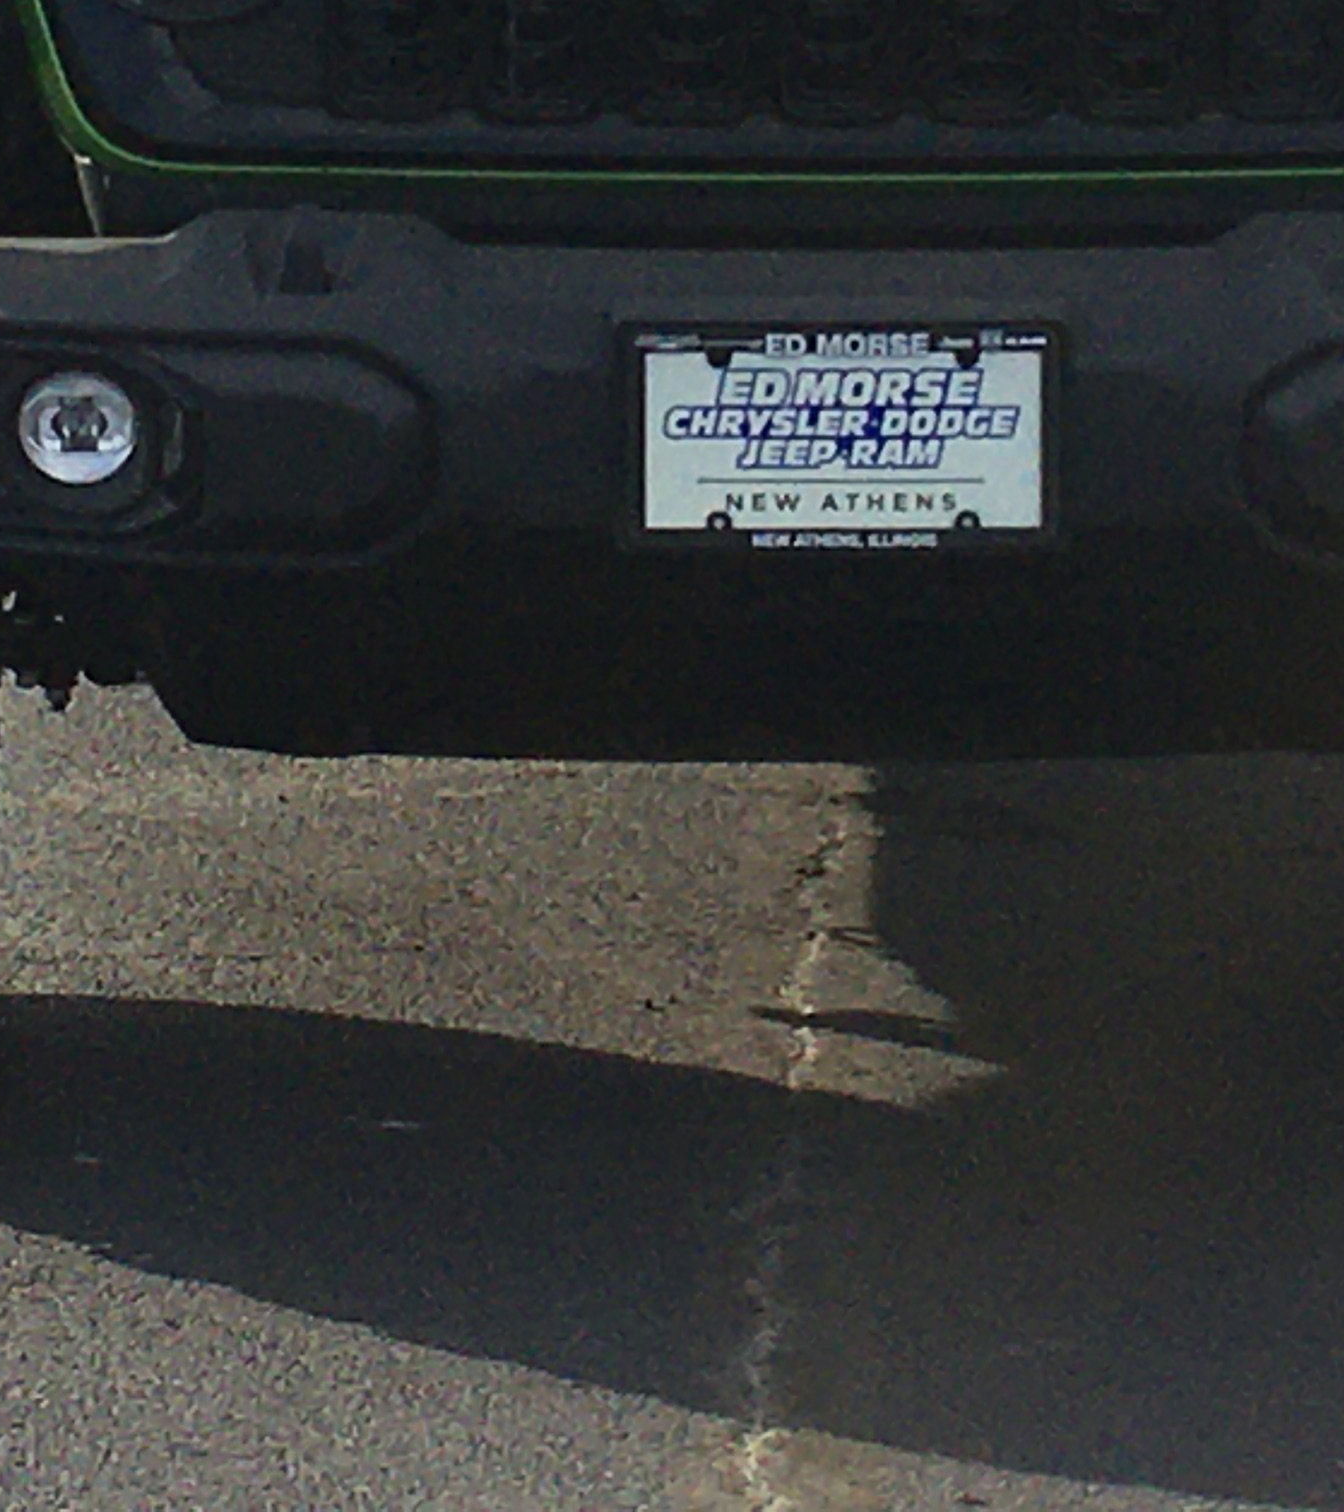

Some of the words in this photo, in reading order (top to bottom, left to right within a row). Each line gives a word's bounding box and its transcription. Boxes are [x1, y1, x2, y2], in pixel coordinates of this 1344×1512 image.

[765, 333, 807, 356] ED
[816, 333, 930, 356] MORSE
[718, 368, 790, 406] ED
[793, 368, 984, 406] MORSE
[663, 406, 870, 438] CHRYSLER
[880, 406, 1020, 438] DODGE
[738, 439, 840, 469] JEEP
[847, 439, 944, 468] RAM
[726, 493, 800, 512] NEW
[821, 492, 957, 512] ATHENS
